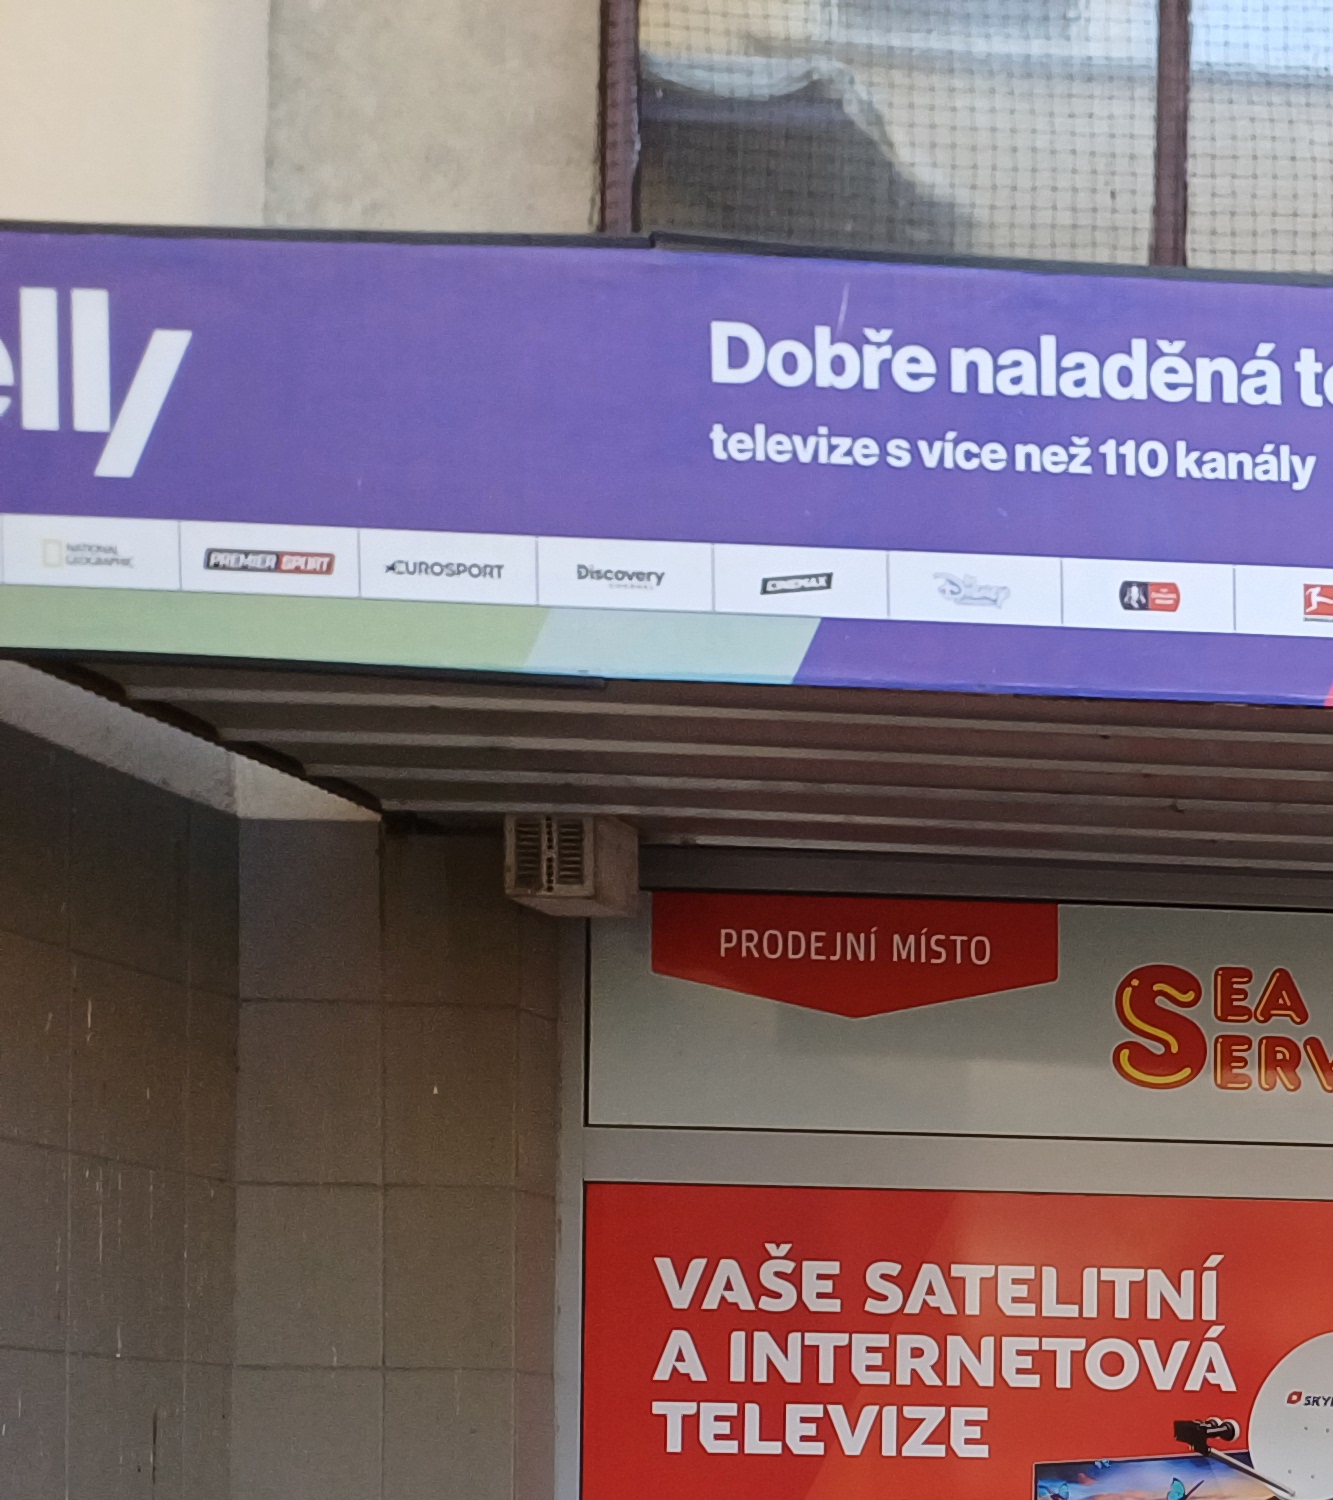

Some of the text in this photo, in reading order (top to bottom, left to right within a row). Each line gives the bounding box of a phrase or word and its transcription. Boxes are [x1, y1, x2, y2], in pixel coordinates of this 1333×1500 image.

[0, 286, 193, 478] lly
[709, 319, 937, 392] Dobře
[949, 337, 1282, 406] naladěná
[709, 422, 880, 468] televize
[886, 440, 909, 468] s
[916, 429, 1007, 472] více
[1015, 431, 1093, 475] než
[1098, 437, 1167, 479] 110
[1174, 440, 1317, 491] kanály
[208, 551, 278, 571] PREMIER
[576, 564, 665, 587] Discovery
[718, 924, 991, 967] PRODEJNÍ MÍSTO
[653, 1241, 1226, 1323] VAŠE SATELITNÍ
[651, 1324, 1237, 1393] A INTERNETOVÁ
[652, 1401, 990, 1459] TELEVIZE
